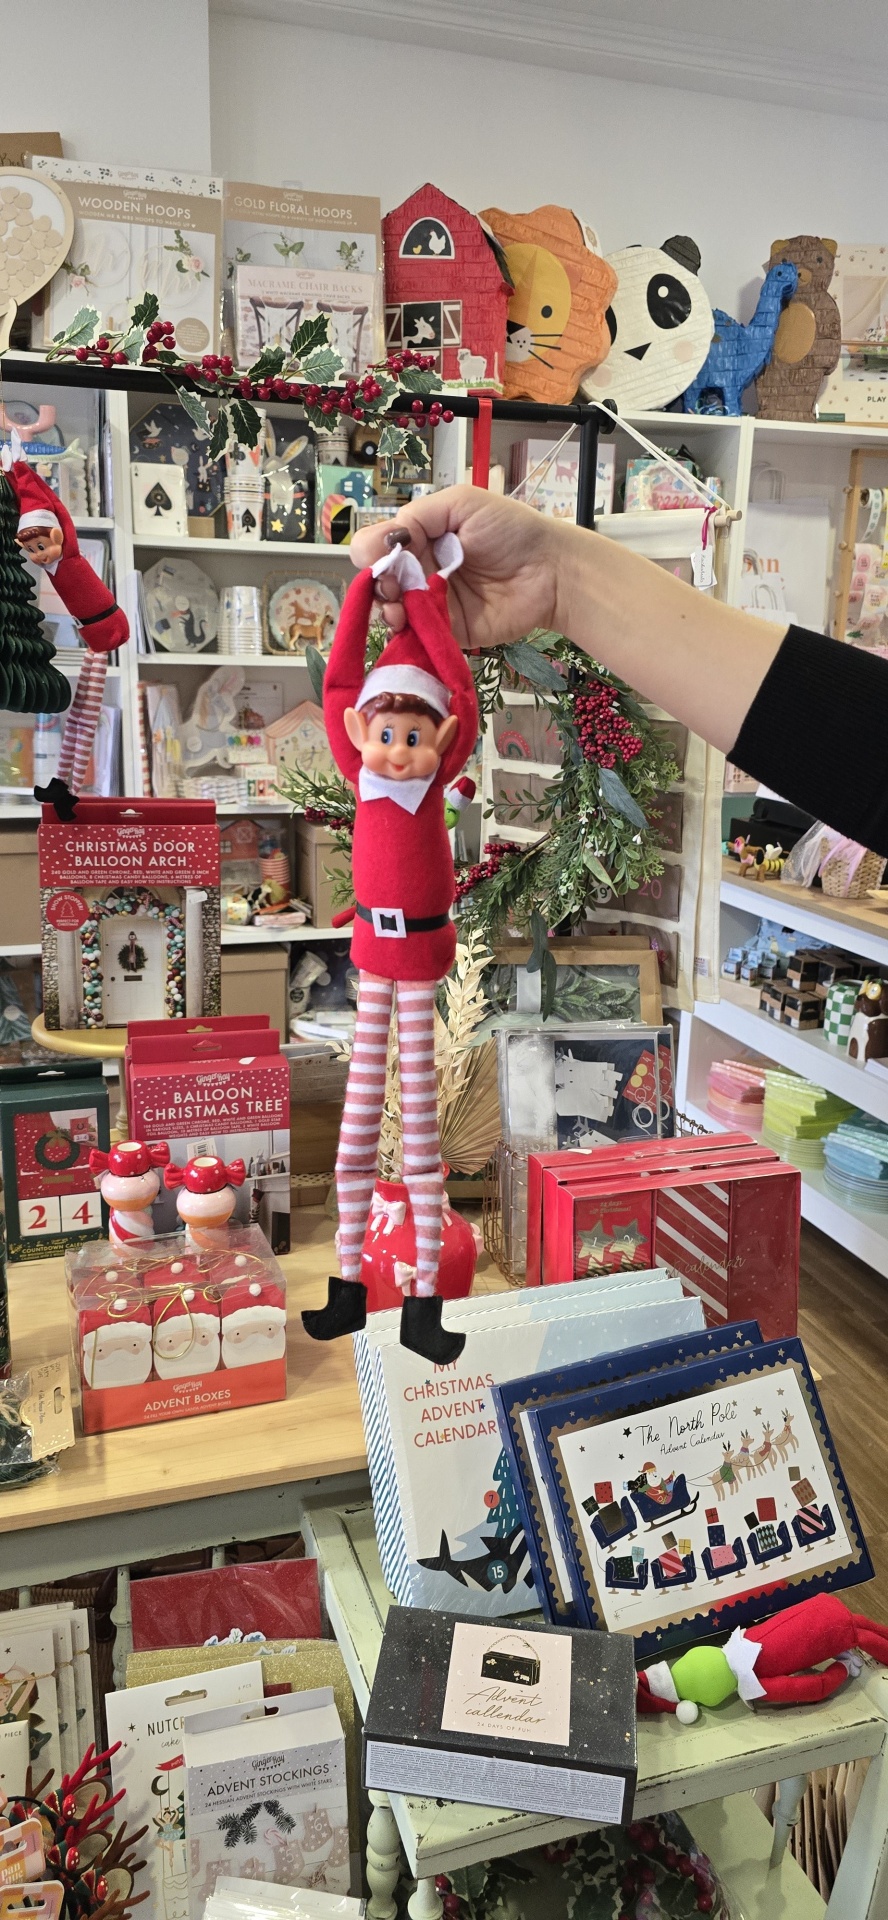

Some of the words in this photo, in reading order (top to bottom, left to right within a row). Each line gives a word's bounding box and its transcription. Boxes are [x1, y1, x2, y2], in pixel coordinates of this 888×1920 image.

[78, 196, 140, 213] WOODEN
[145, 204, 191, 219] HOOPS
[234, 196, 266, 210] GOLD
[270, 201, 310, 216] FLORAL
[313, 206, 352, 220] HOOPS
[248, 279, 294, 290] MACRAME
[299, 281, 329, 291] CHAIR
[332, 284, 363, 293] BACKS
[506, 711, 512, 724] 9
[65, 841, 148, 852] CHRISTMAS
[153, 842, 196, 852] DOOR
[74, 856, 143, 867] BALLOON
[148, 856, 187, 867] ARCH
[50, 896, 63, 910] SHOW
[196, 1074, 218, 1086] Ginger
[218, 1073, 230, 1082] Ray
[174, 1087, 252, 1104] BALLOON
[143, 1103, 240, 1121] CHRISTMAS
[246, 1099, 283, 1112] TREE
[28, 1204, 47, 1230] 2
[72, 1200, 94, 1224] 4
[591, 1237, 598, 1247] 1
[624, 1235, 633, 1244] 2
[22, 1245, 64, 1254] COUNTDOWN
[685, 1254, 746, 1276] calendar
[404, 1374, 494, 1402] CHRISTMAS
[144, 1396, 191, 1412] ADVENT
[194, 1389, 231, 1404] BOXES
[421, 1399, 483, 1423] ADVENT
[635, 1424, 660, 1446] The
[669, 1410, 704, 1438] North
[711, 1402, 737, 1426] Pole
[414, 1420, 497, 1447] CALENDAR
[660, 1442, 687, 1455] Advent
[690, 1431, 725, 1447] Calendar
[489, 1494, 494, 1504] 7
[492, 1566, 504, 1579] 15
[463, 1686, 543, 1706] Advent
[465, 1705, 546, 1724] callendar
[161, 1737, 180, 1748] cake
[252, 1756, 272, 1770] Ginger
[272, 1755, 285, 1764] Ray
[207, 1778, 256, 1797] ADVENT
[260, 1764, 330, 1787] STOCKINGS
[212, 1798, 235, 1806] HESSIAN
[257, 1787, 286, 1797] STOCKINGS
[314, 1817, 322, 1831] 6
[286, 1850, 294, 1863] 5
[2, 1862, 20, 1880] pan
